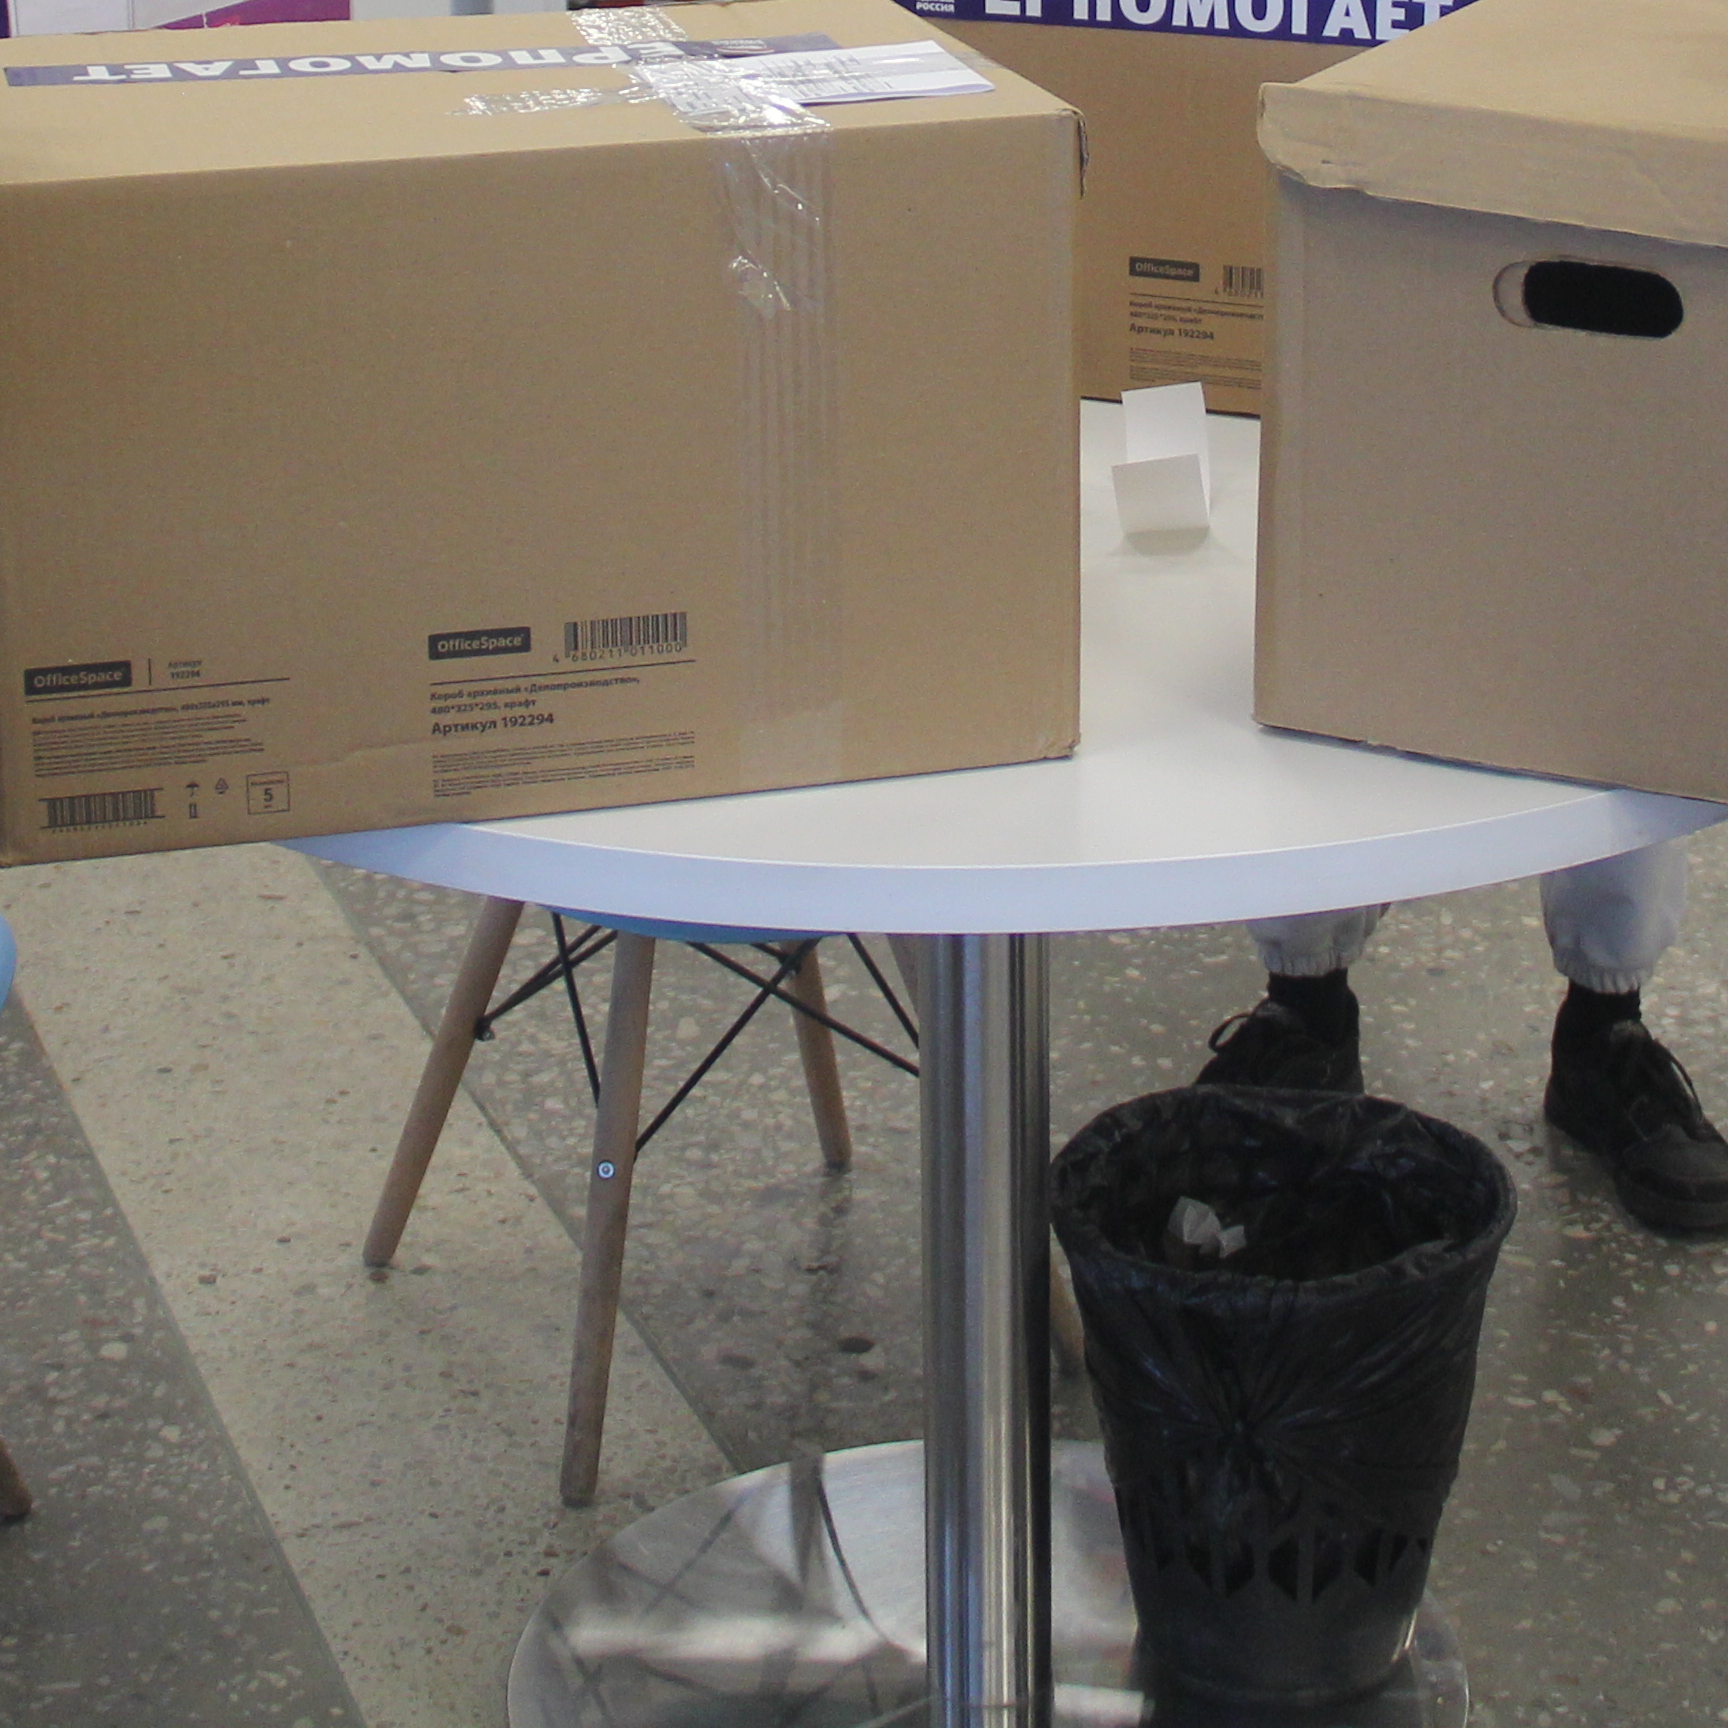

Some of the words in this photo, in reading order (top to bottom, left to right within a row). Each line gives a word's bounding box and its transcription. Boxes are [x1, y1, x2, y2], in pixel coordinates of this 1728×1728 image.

[915, 1, 955, 13] РОССИЯ
[1129, 323, 1175, 338] Артикул
[1178, 328, 1215, 341] 192294
[438, 635, 522, 653] OfficeSpace
[34, 669, 124, 689] OfficeSpace
[431, 719, 497, 737] Артикул
[502, 712, 555, 728] 192294
